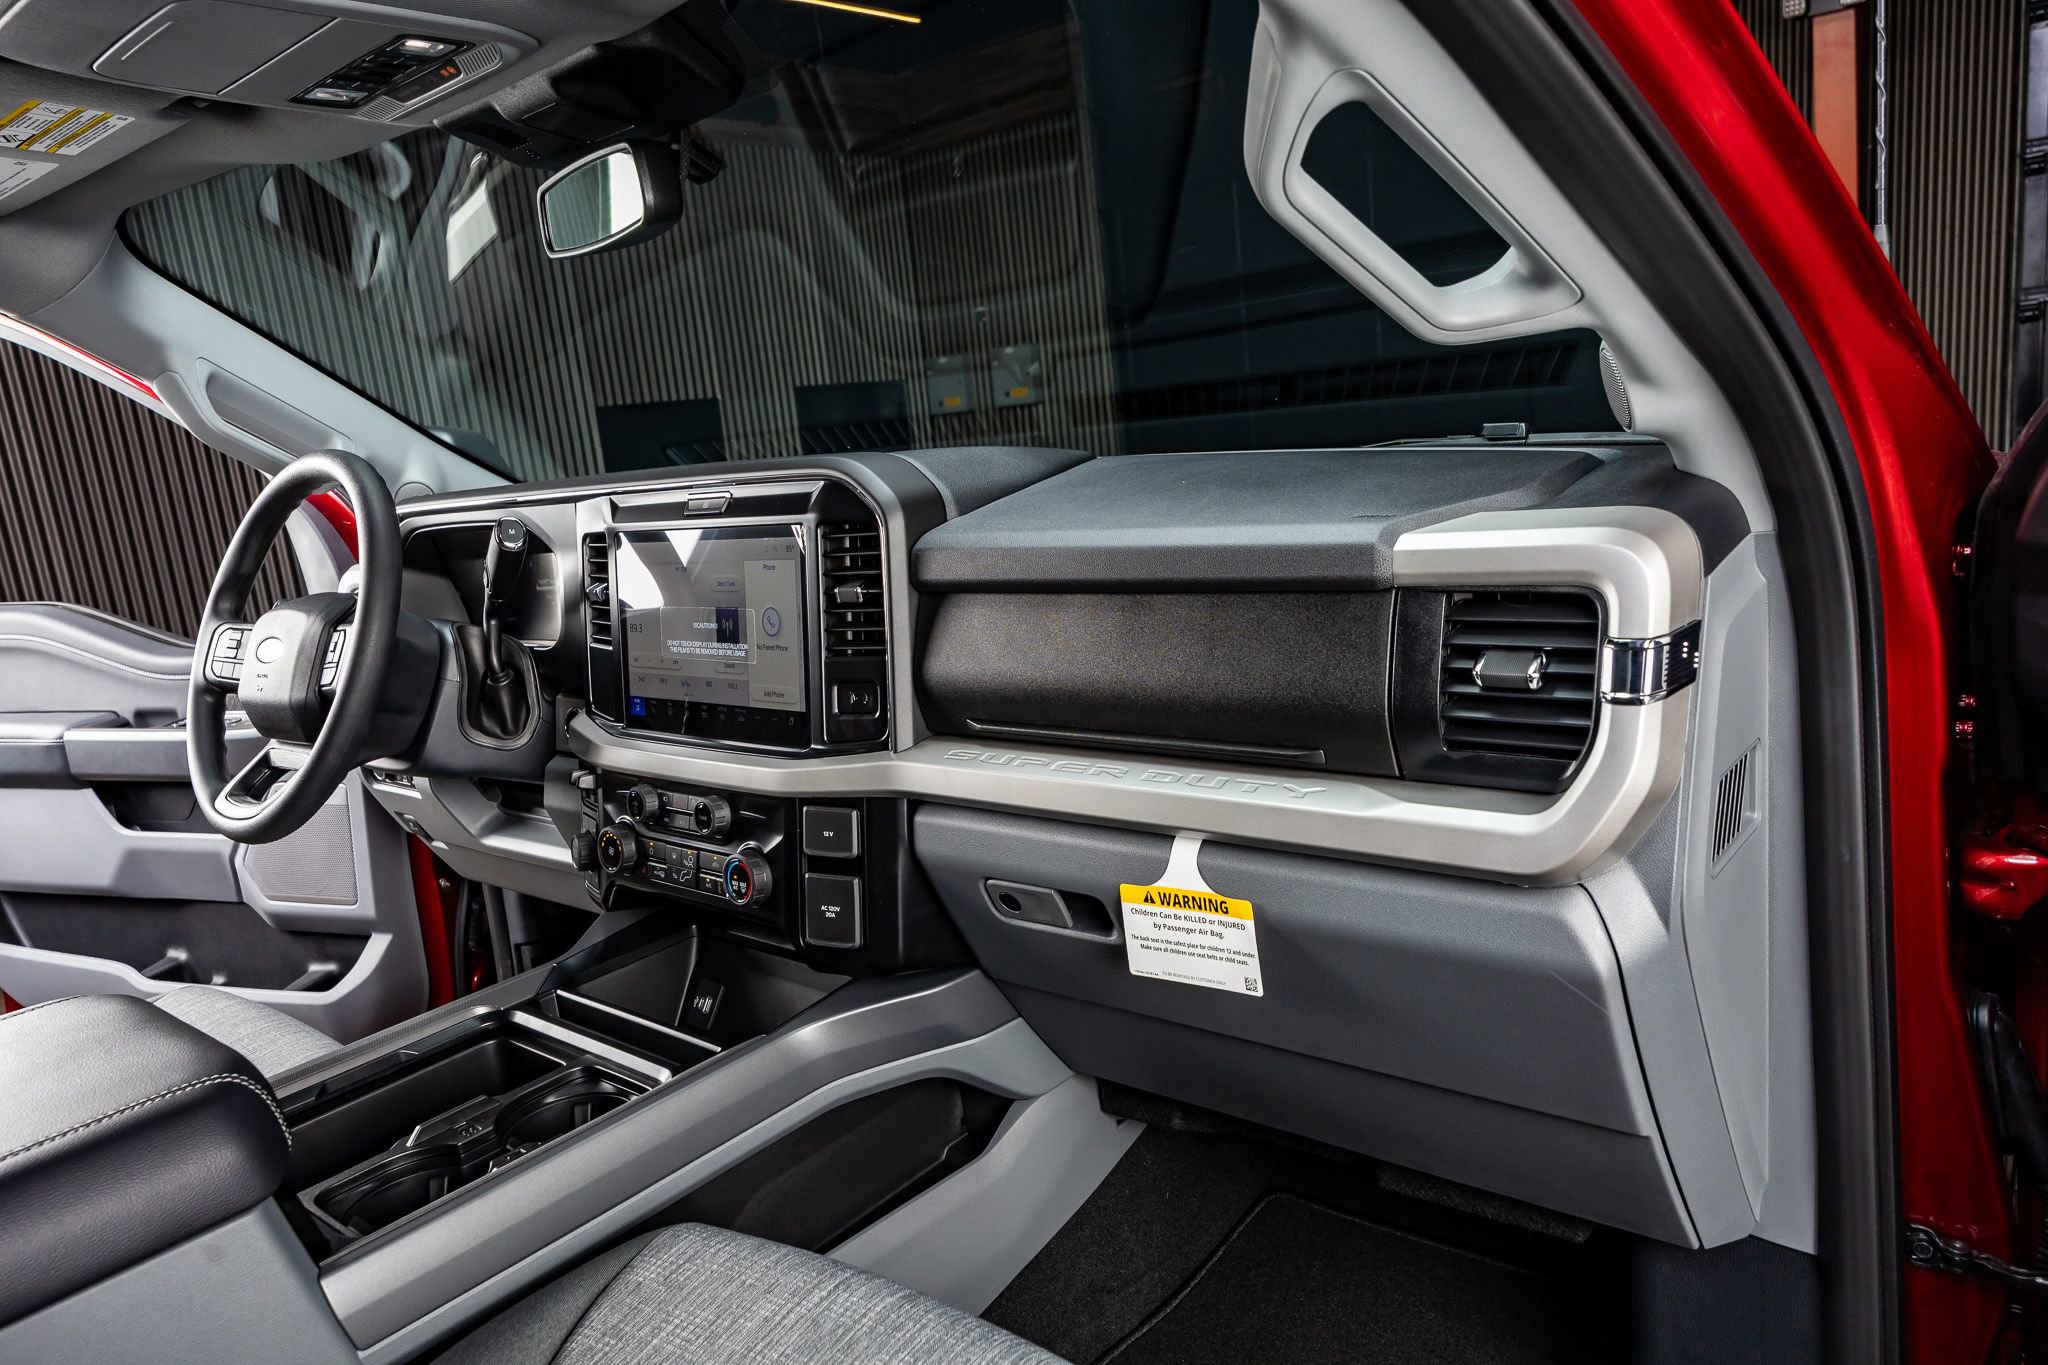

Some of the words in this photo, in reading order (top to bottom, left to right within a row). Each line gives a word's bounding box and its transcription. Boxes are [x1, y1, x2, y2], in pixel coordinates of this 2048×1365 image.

[629, 623, 643, 633] 89.3
[772, 691, 785, 699] Phone
[943, 748, 1129, 779] SUPER
[1138, 769, 1328, 799] DUTY
[1158, 892, 1229, 914] WARNING
[1130, 907, 1158, 918] Children
[1159, 912, 1172, 920] Can
[1173, 913, 1182, 921] Be
[1184, 915, 1207, 924] KILLED
[1218, 919, 1246, 931] INJURED
[1153, 922, 1162, 931] by
[1163, 923, 1197, 935] Passenger
[1198, 928, 1208, 936] Air
[1140, 935, 1149, 943] back
[1173, 940, 1186, 948] safest
[1187, 942, 1198, 950] place
[1207, 944, 1225, 954] children
[1242, 951, 1257, 959] under.
[1140, 943, 1152, 951] Make
[1169, 947, 1187, 956] children
[1207, 953, 1218, 961] belts
[1224, 955, 1236, 964] child
[1236, 958, 1250, 966] seats.
